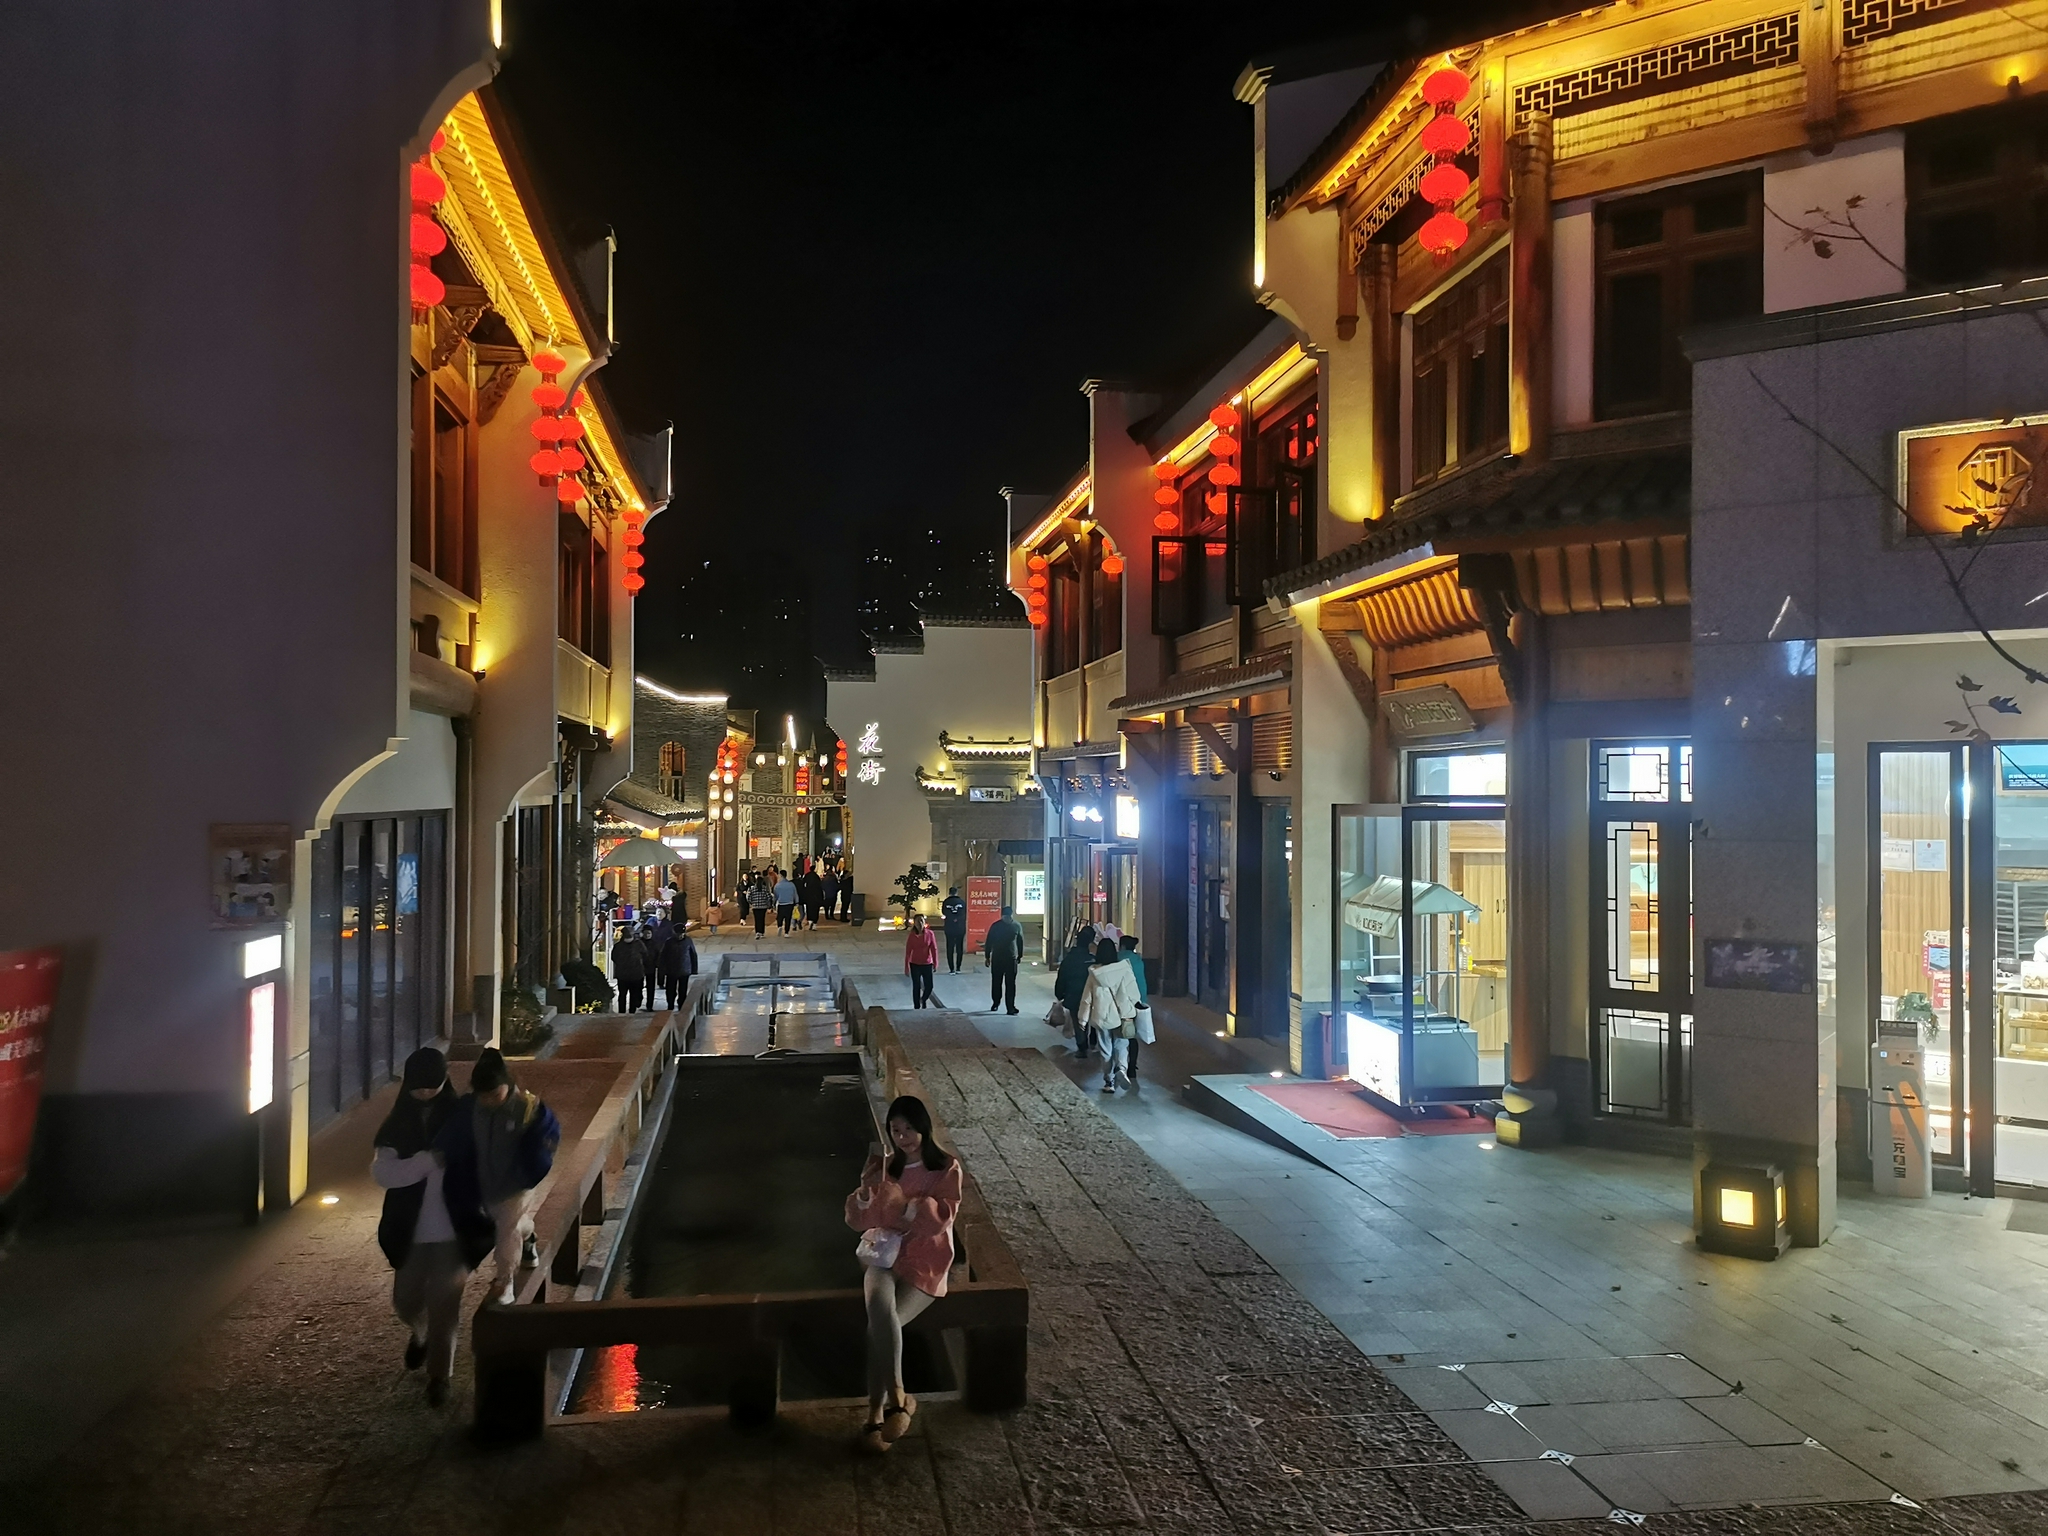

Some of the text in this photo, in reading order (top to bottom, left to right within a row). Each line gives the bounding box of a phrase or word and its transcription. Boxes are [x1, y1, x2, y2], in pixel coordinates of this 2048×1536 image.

[857, 722, 886, 786] 花街
[1892, 1142, 1906, 1178] 充电宝
